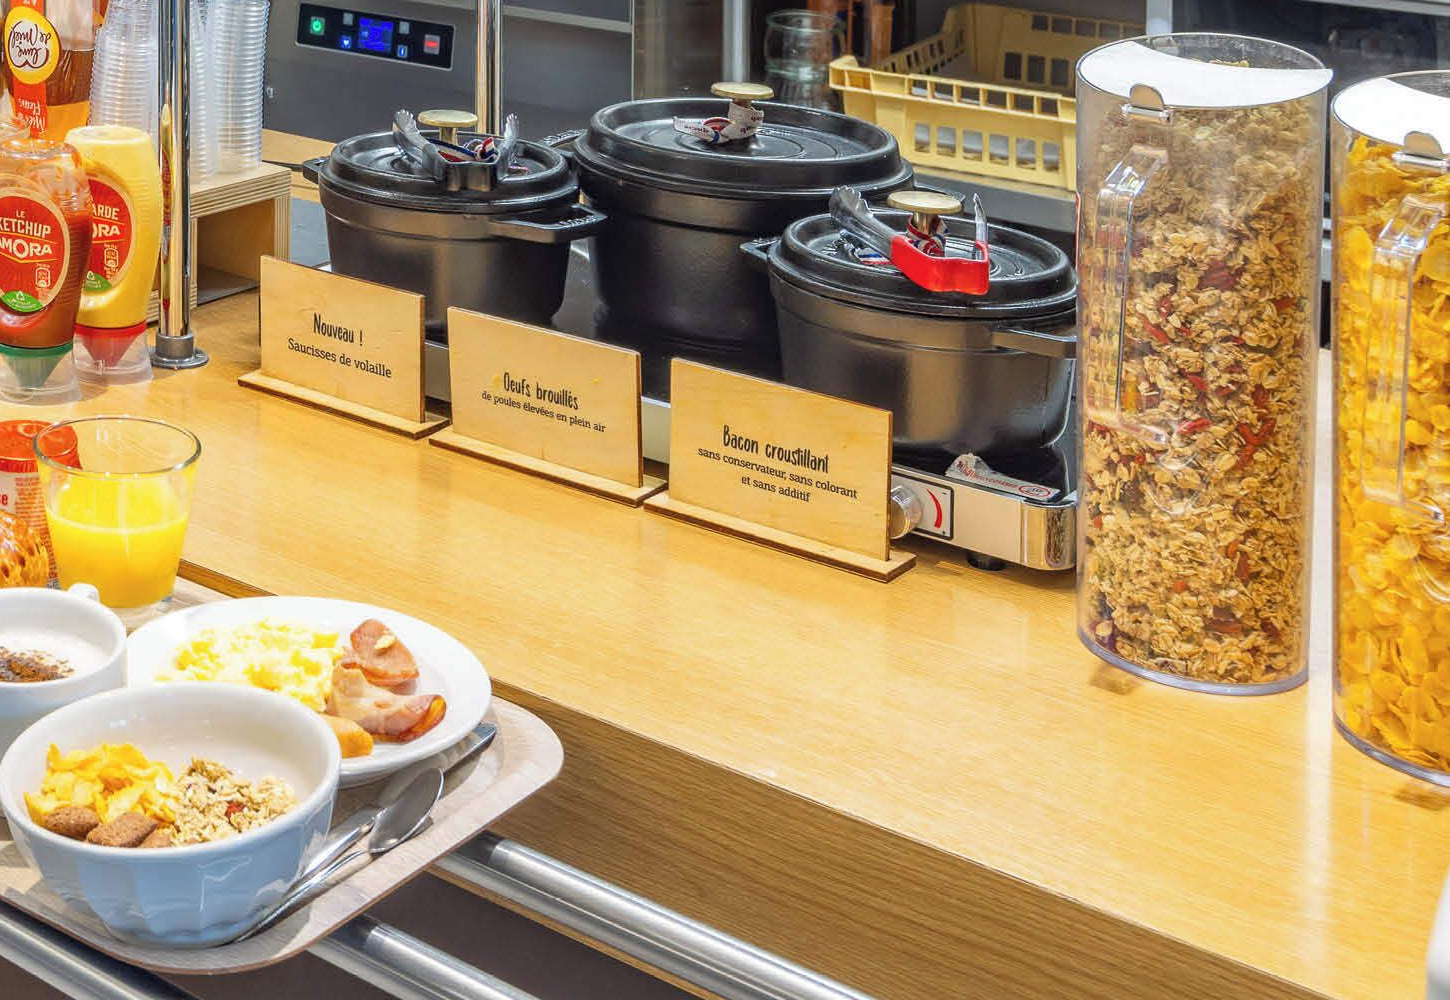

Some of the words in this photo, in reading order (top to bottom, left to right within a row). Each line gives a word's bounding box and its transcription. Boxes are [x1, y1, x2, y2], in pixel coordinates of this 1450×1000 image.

[16, 210, 25, 219] LE
[92, 203, 120, 220] ARDE
[313, 312, 354, 344] Nouveau
[288, 337, 337, 363] Saucisses
[339, 353, 352, 367] de
[354, 359, 392, 378] volaille
[503, 372, 531, 398] Oeufs
[536, 381, 580, 411] brouillés
[481, 391, 492, 401] de
[494, 394, 521, 410] poules
[523, 402, 554, 419] élevées
[556, 413, 568, 423] en
[569, 415, 591, 430] plein
[593, 422, 607, 433] air
[723, 424, 759, 454] Bacon
[765, 442, 830, 474] croustillant
[698, 447, 721, 462] sans
[722, 454, 787, 481] conservateur,
[789, 473, 813, 487] sans
[815, 479, 859, 500] colorant
[741, 475, 751, 487] et
[752, 478, 776, 493] sans
[778, 485, 812, 503] additif
